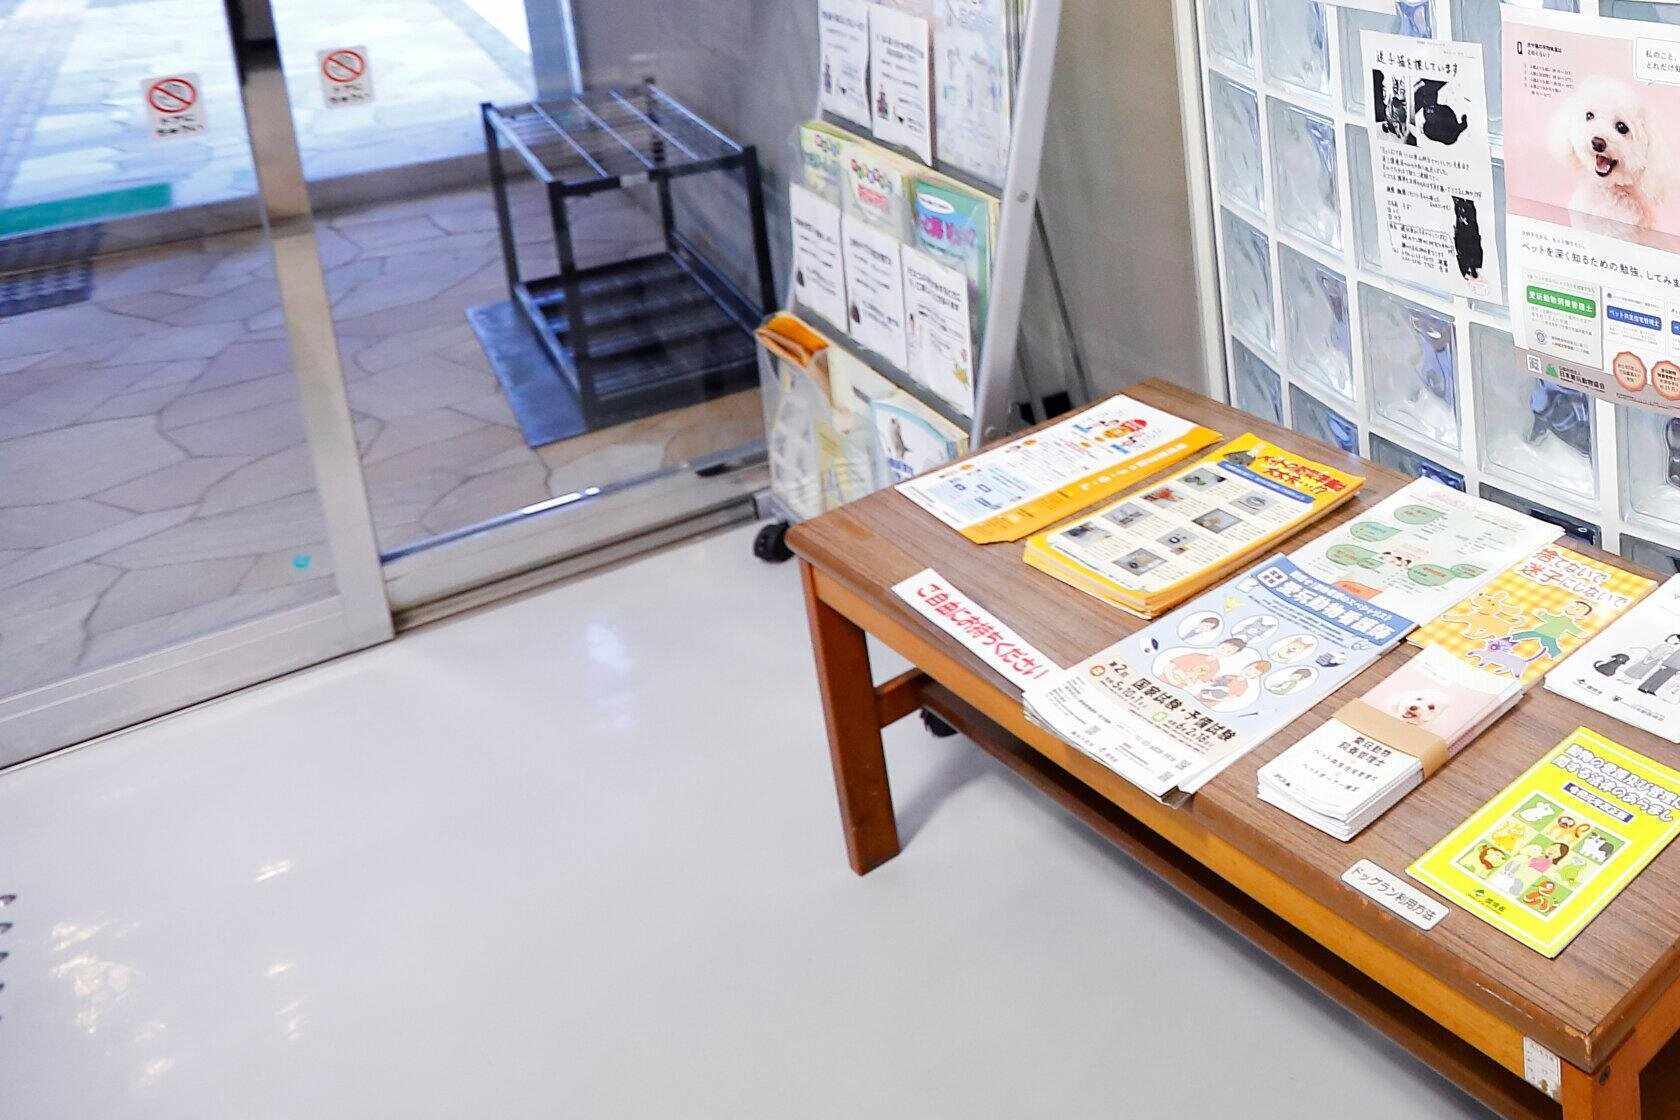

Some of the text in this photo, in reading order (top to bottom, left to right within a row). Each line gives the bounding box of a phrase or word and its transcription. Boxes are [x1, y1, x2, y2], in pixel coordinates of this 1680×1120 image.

[915, 582, 1050, 681] ご自由にお持ちください
[1352, 867, 1438, 922] ドッグラン利用方法
